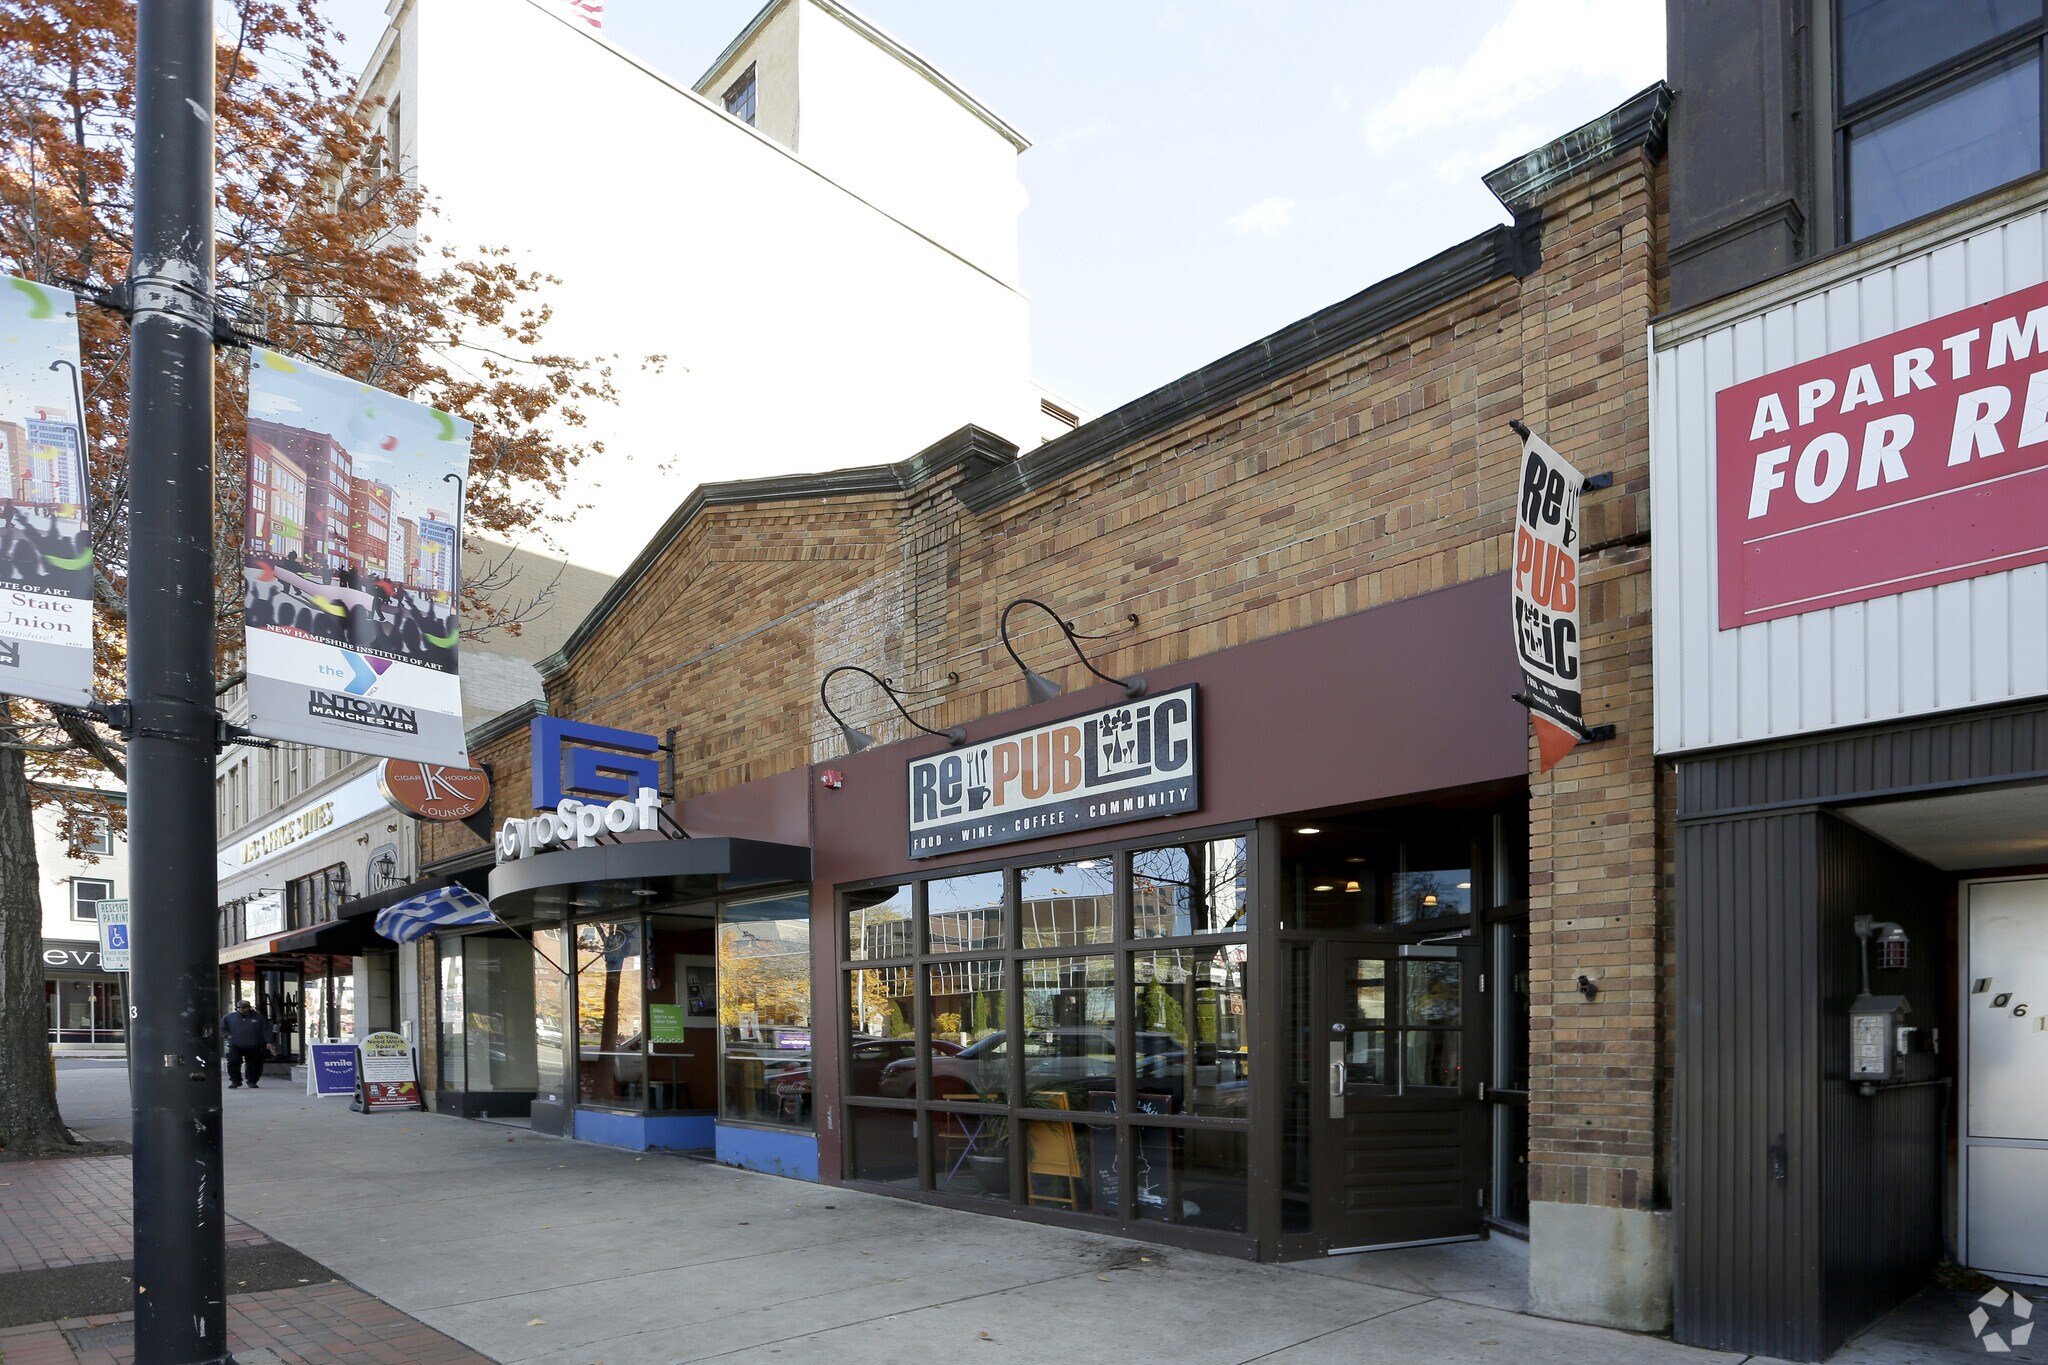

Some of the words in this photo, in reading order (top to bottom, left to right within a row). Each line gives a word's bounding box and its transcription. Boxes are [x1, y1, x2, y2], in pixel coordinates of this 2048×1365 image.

[1749, 305, 2048, 441] APARTM
[1748, 413, 1916, 520] FOR
[1947, 369, 2048, 467] RE
[1521, 451, 1565, 530] Re
[1515, 524, 1576, 614] PUB
[12, 592, 73, 613] State
[22, 584, 41, 593] OF
[44, 587, 71, 597] ART
[266, 623, 292, 636] NEW
[294, 630, 354, 651] HAMPSHIRE
[356, 645, 409, 664] INSTITUTE
[410, 656, 423, 666] OF
[424, 660, 443, 671] ART
[319, 664, 344, 678] the
[309, 690, 416, 723] INTOWN
[312, 706, 414, 732] MANCHESTER
[419, 803, 475, 818] LOUNGE
[914, 835, 942, 851] FOOD
[961, 824, 994, 841] WINE
[1015, 811, 1065, 831] COFFEE
[1089, 787, 1189, 818] COMMUNITY
[101, 903, 128, 913] RESERVED
[324, 1058, 353, 1067] smile
